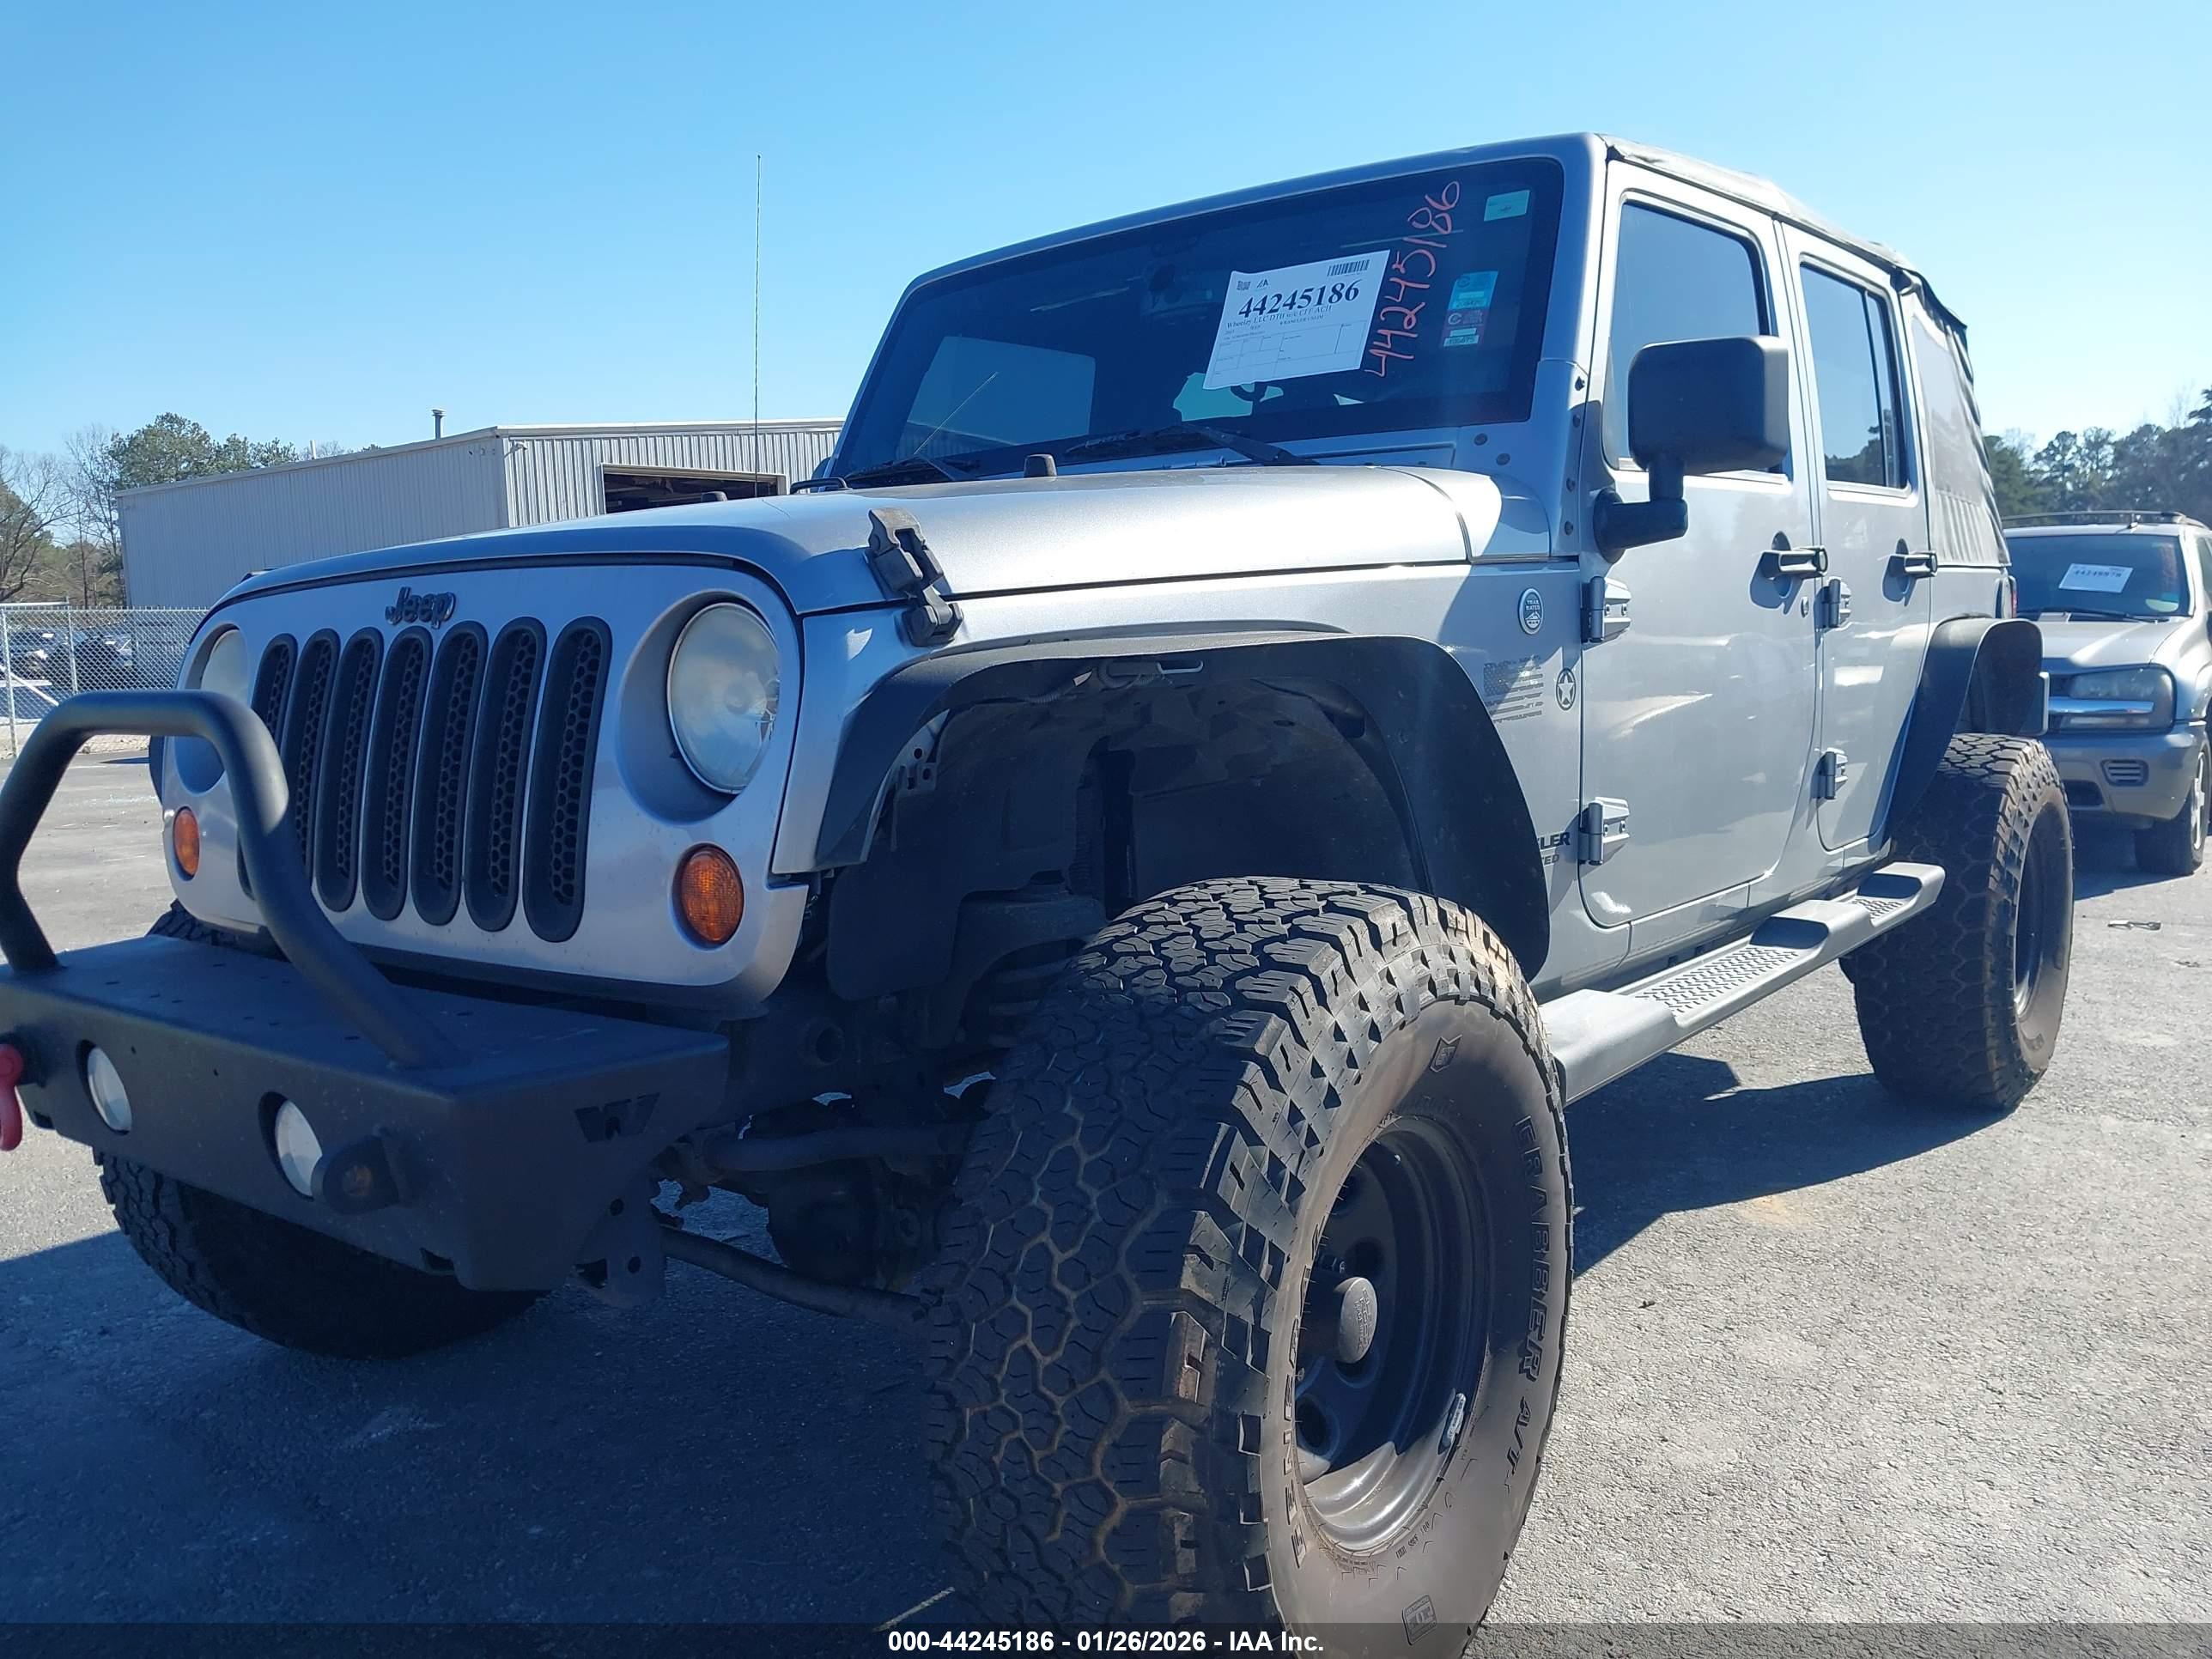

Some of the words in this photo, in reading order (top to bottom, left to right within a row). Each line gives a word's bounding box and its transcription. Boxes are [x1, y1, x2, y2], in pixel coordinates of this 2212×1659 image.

[1238, 278, 1363, 319] 44245186
[1364, 181, 1460, 378] 44245186
[385, 586, 456, 629] Jeep
[1538, 832, 1571, 850] LER
[1514, 1115, 1551, 1382] GRABBER
